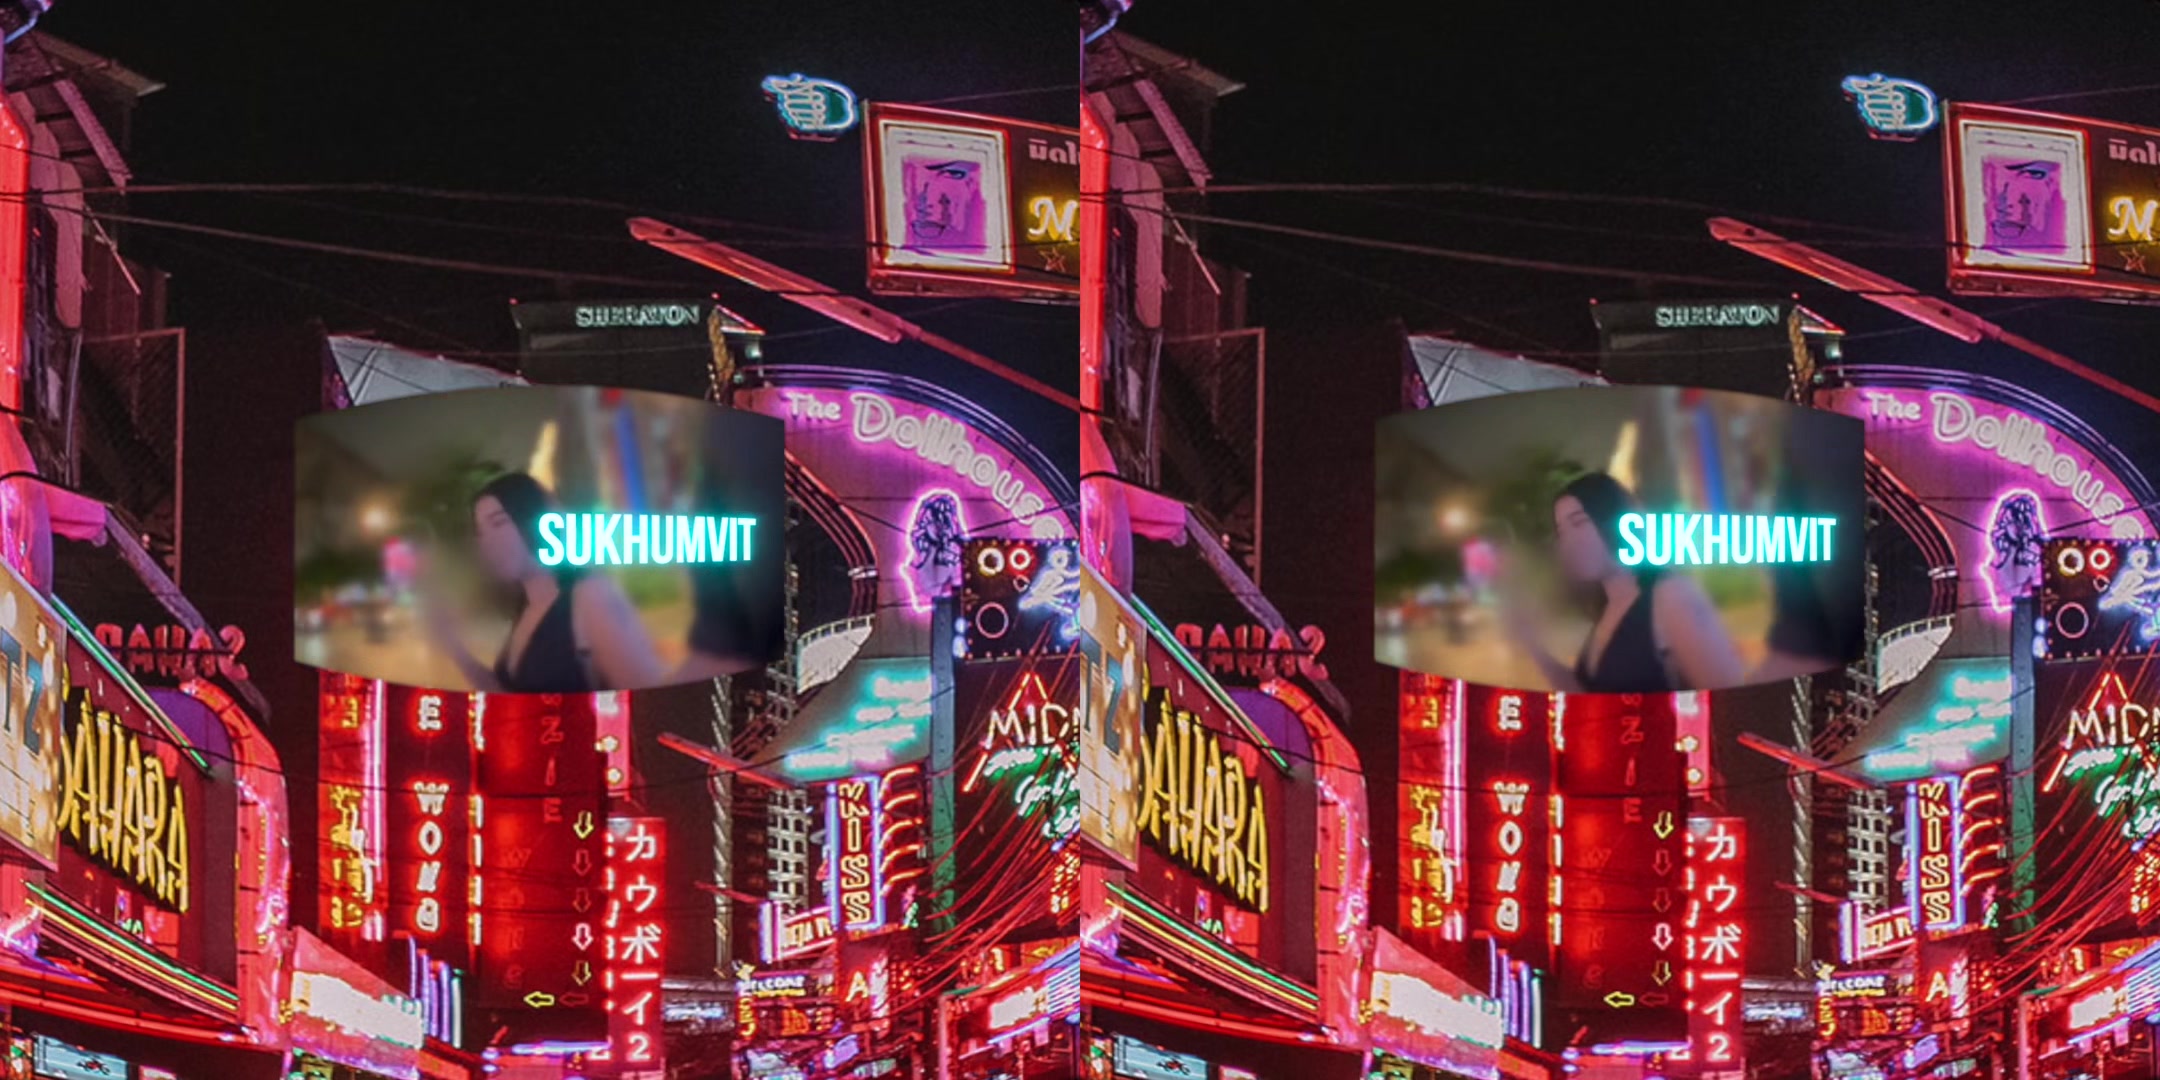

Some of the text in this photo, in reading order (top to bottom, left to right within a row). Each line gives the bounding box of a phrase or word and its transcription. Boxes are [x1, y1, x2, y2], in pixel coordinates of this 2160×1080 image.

[575, 304, 700, 328] SHERATON
[1655, 304, 1780, 328] SHERATON
[784, 391, 1065, 540] The Dollhouse
[1864, 391, 2145, 540] The Dollhouse
[838, 781, 871, 924] KISS
[1918, 781, 1951, 924] KISS
